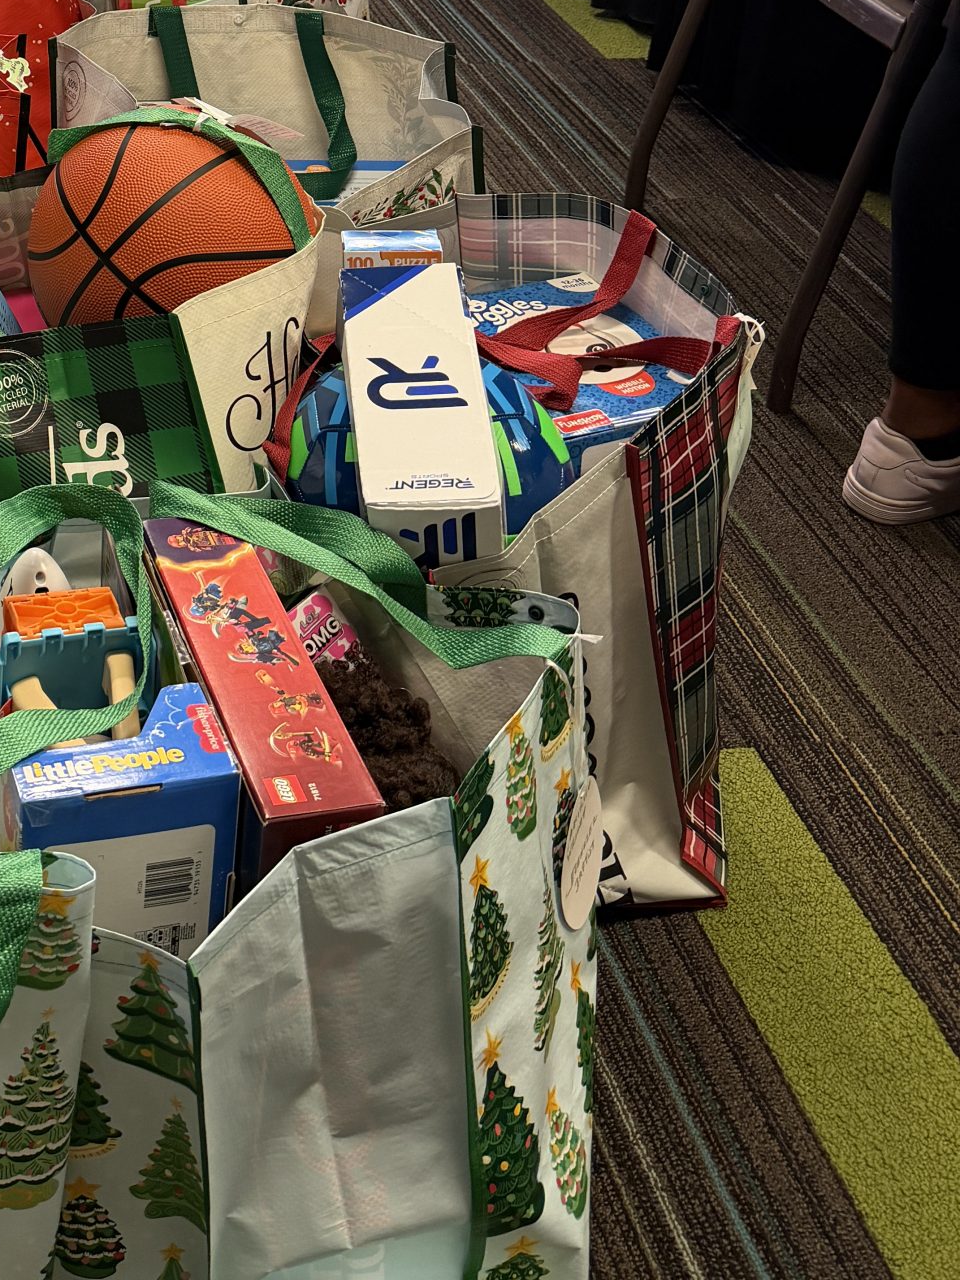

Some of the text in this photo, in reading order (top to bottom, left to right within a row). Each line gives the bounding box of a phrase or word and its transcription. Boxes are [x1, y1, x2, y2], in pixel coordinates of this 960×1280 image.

[346, 256, 374, 268] 100
[561, 280, 594, 290] months
[615, 378, 645, 390] WOBBLE
[622, 383, 651, 396] MOTION
[389, 477, 475, 490] REGENT
[22, 746, 186, 785] Little People
[272, 776, 297, 803] LEGO
[307, 782, 323, 802] 71812
